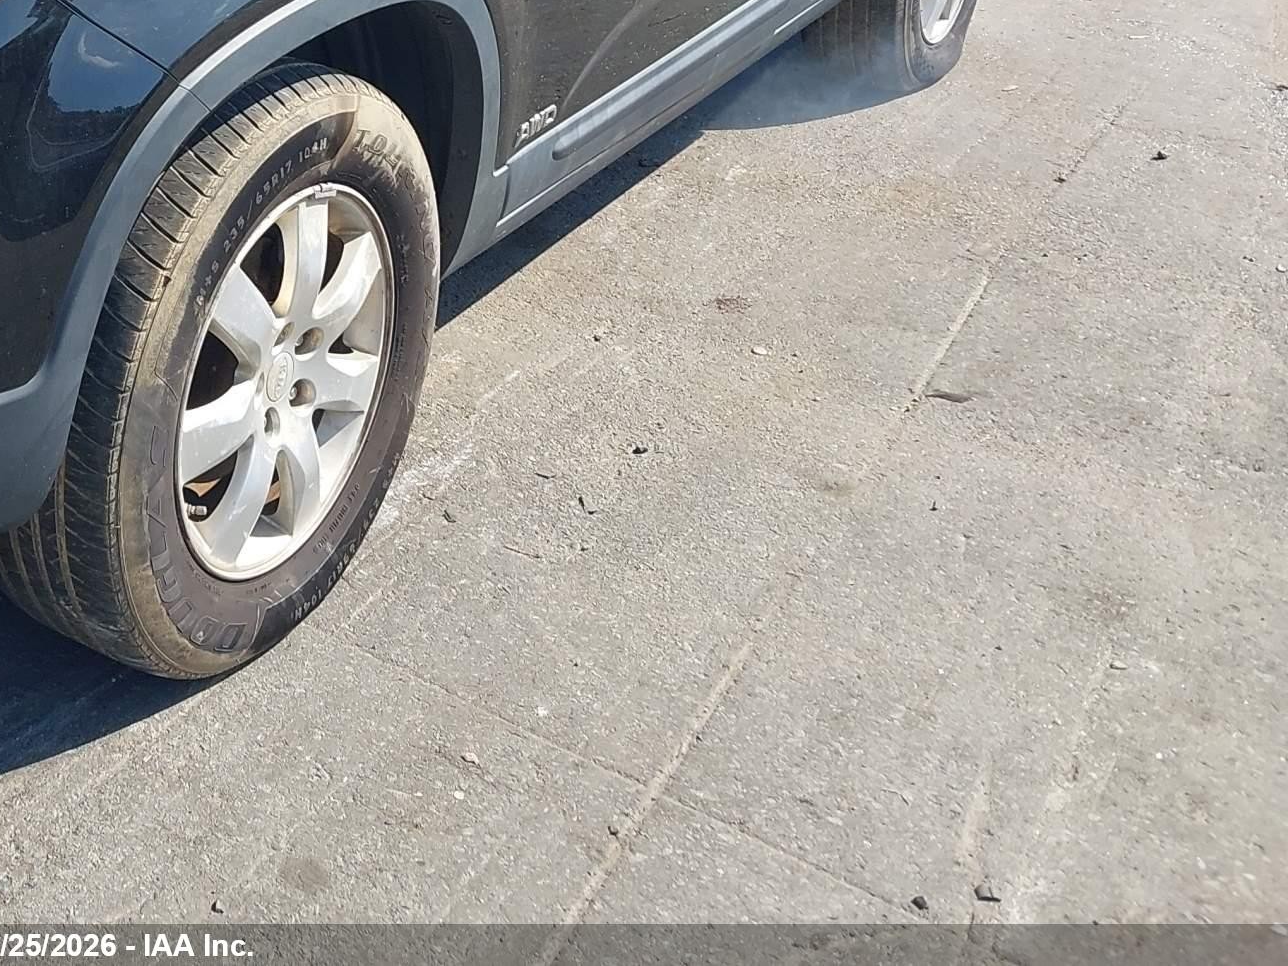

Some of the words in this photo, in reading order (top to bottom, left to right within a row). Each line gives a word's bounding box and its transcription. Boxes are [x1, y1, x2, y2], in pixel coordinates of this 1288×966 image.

[514, 104, 558, 148] AWD
[222, 158, 294, 254] 235/65R17
[297, 137, 329, 165] 104H
